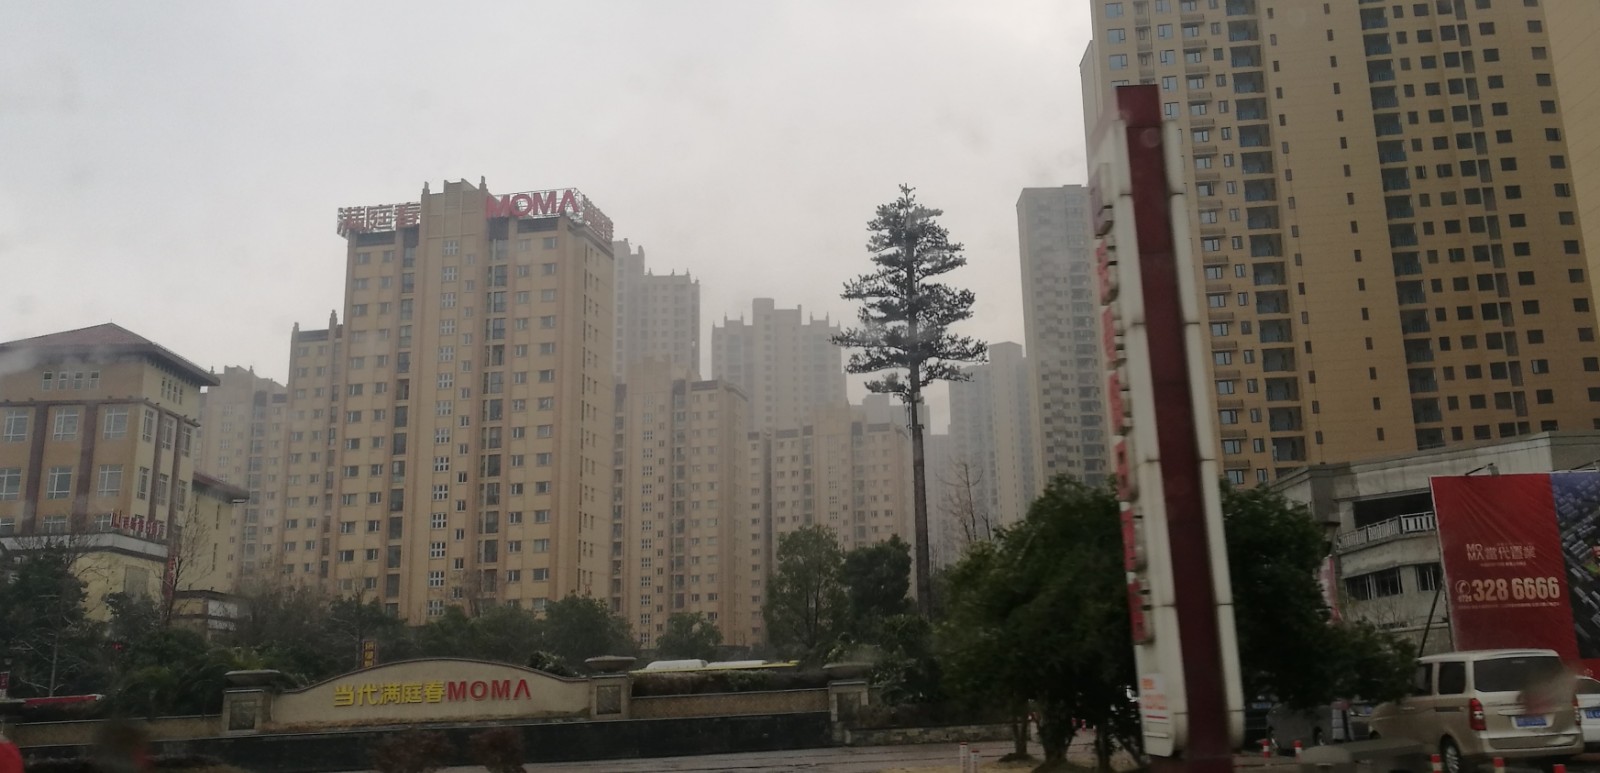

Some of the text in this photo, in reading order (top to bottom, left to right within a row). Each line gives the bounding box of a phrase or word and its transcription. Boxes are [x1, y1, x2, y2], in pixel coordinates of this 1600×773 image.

[486, 190, 581, 218] MOMA
[1471, 576, 1560, 602] 328 6666
